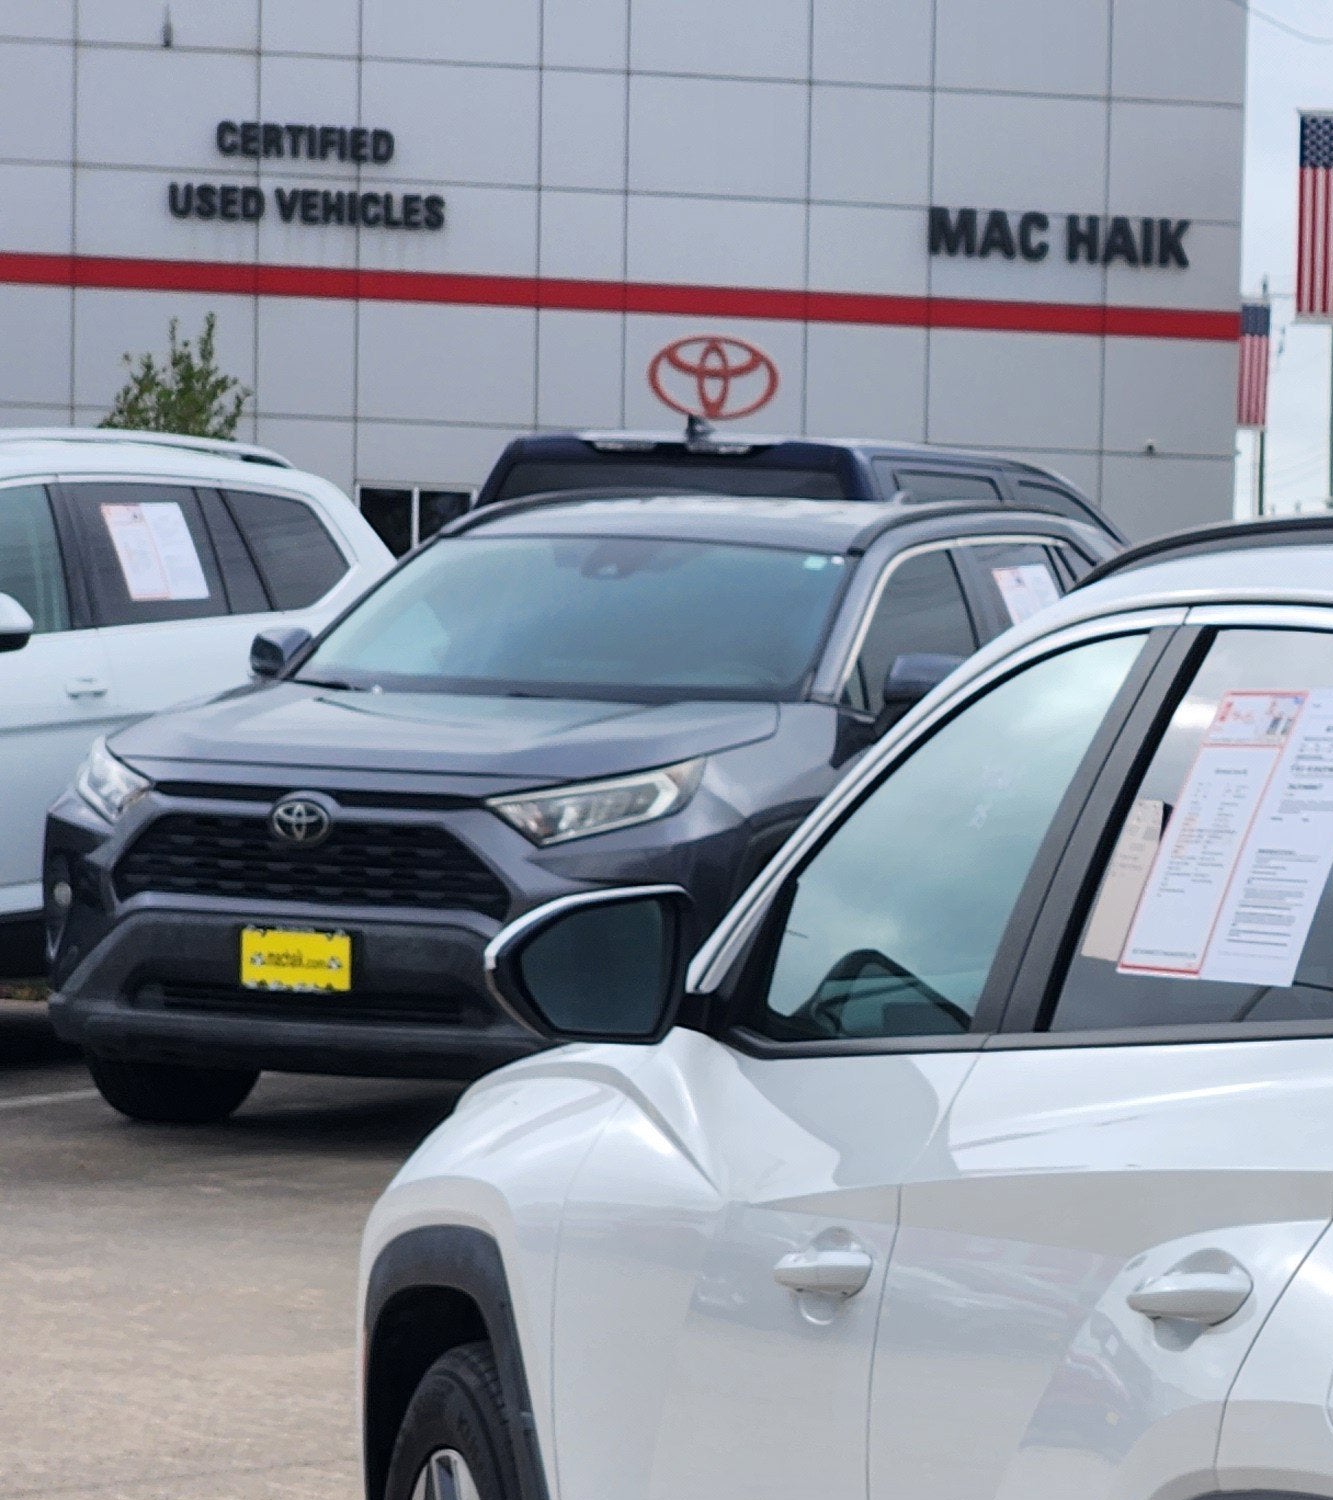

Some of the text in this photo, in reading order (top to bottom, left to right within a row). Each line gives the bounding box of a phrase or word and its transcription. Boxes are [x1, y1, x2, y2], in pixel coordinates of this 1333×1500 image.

[216, 120, 395, 164] CERTIFIED
[168, 182, 446, 230] USED VEHICLES
[928, 206, 1191, 268] MAC HAIK
